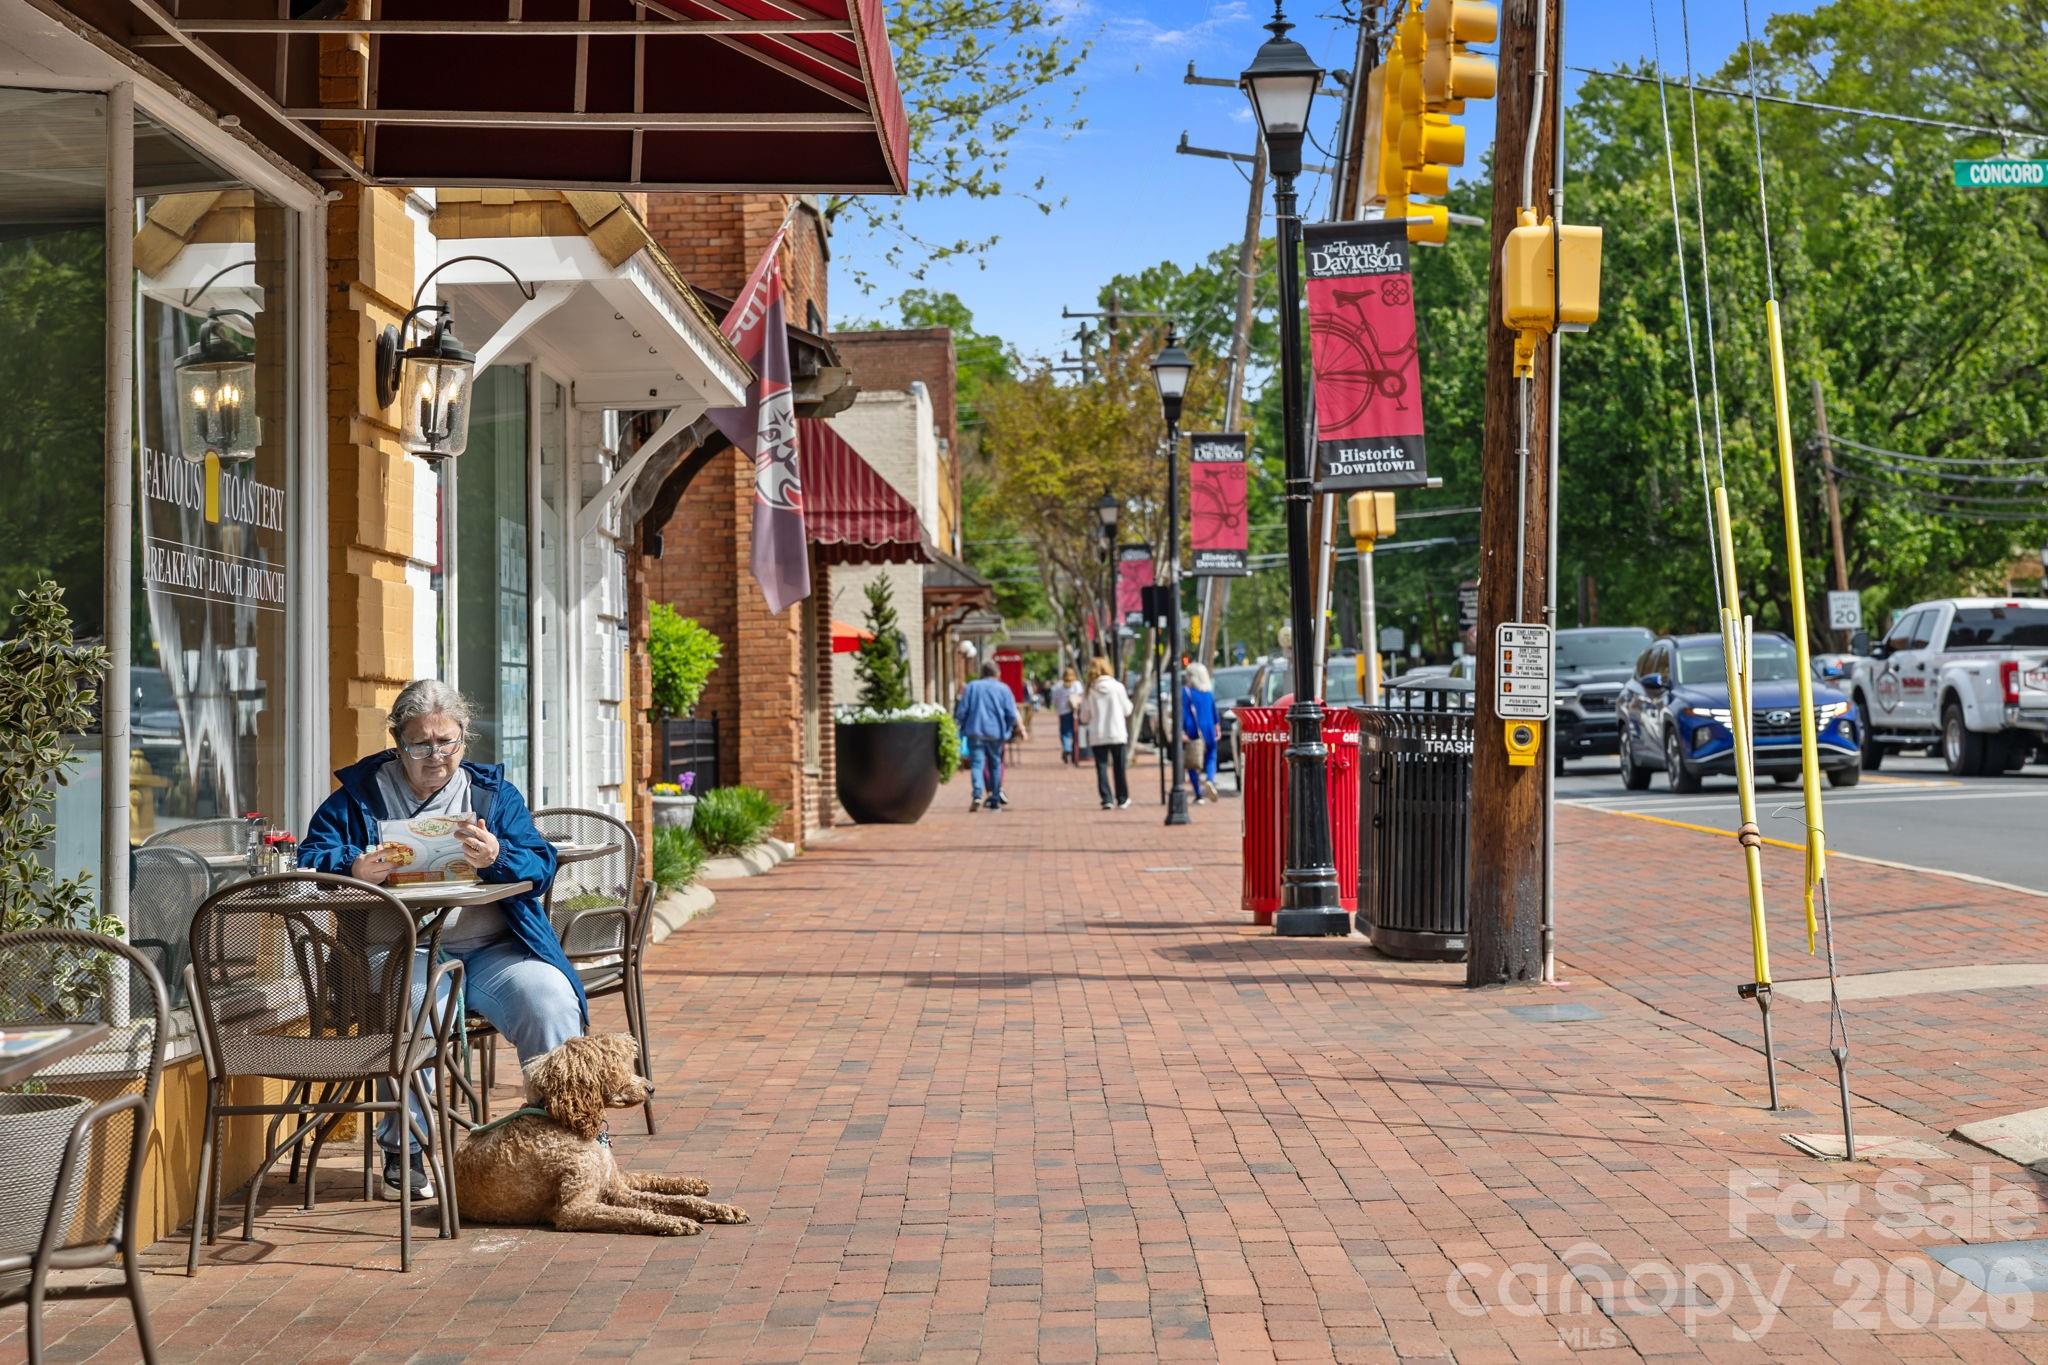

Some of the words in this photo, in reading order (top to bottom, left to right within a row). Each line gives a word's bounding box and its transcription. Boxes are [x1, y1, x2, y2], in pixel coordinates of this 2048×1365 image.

[1970, 163, 2044, 184] CONCORD
[1323, 244, 1341, 254] The
[1334, 241, 1378, 257] Town
[1375, 241, 1391, 256] of
[1311, 252, 1403, 271] Davidson
[1339, 446, 1404, 462] Historic
[1329, 460, 1415, 476] Downtown
[144, 447, 201, 510] FAMOUS
[223, 472, 285, 532] TOASTERY
[209, 558, 243, 597] LUNCH
[247, 566, 285, 604] BRUNCH
[1835, 610, 1857, 624] 20
[1425, 740, 1474, 754] TRASH
